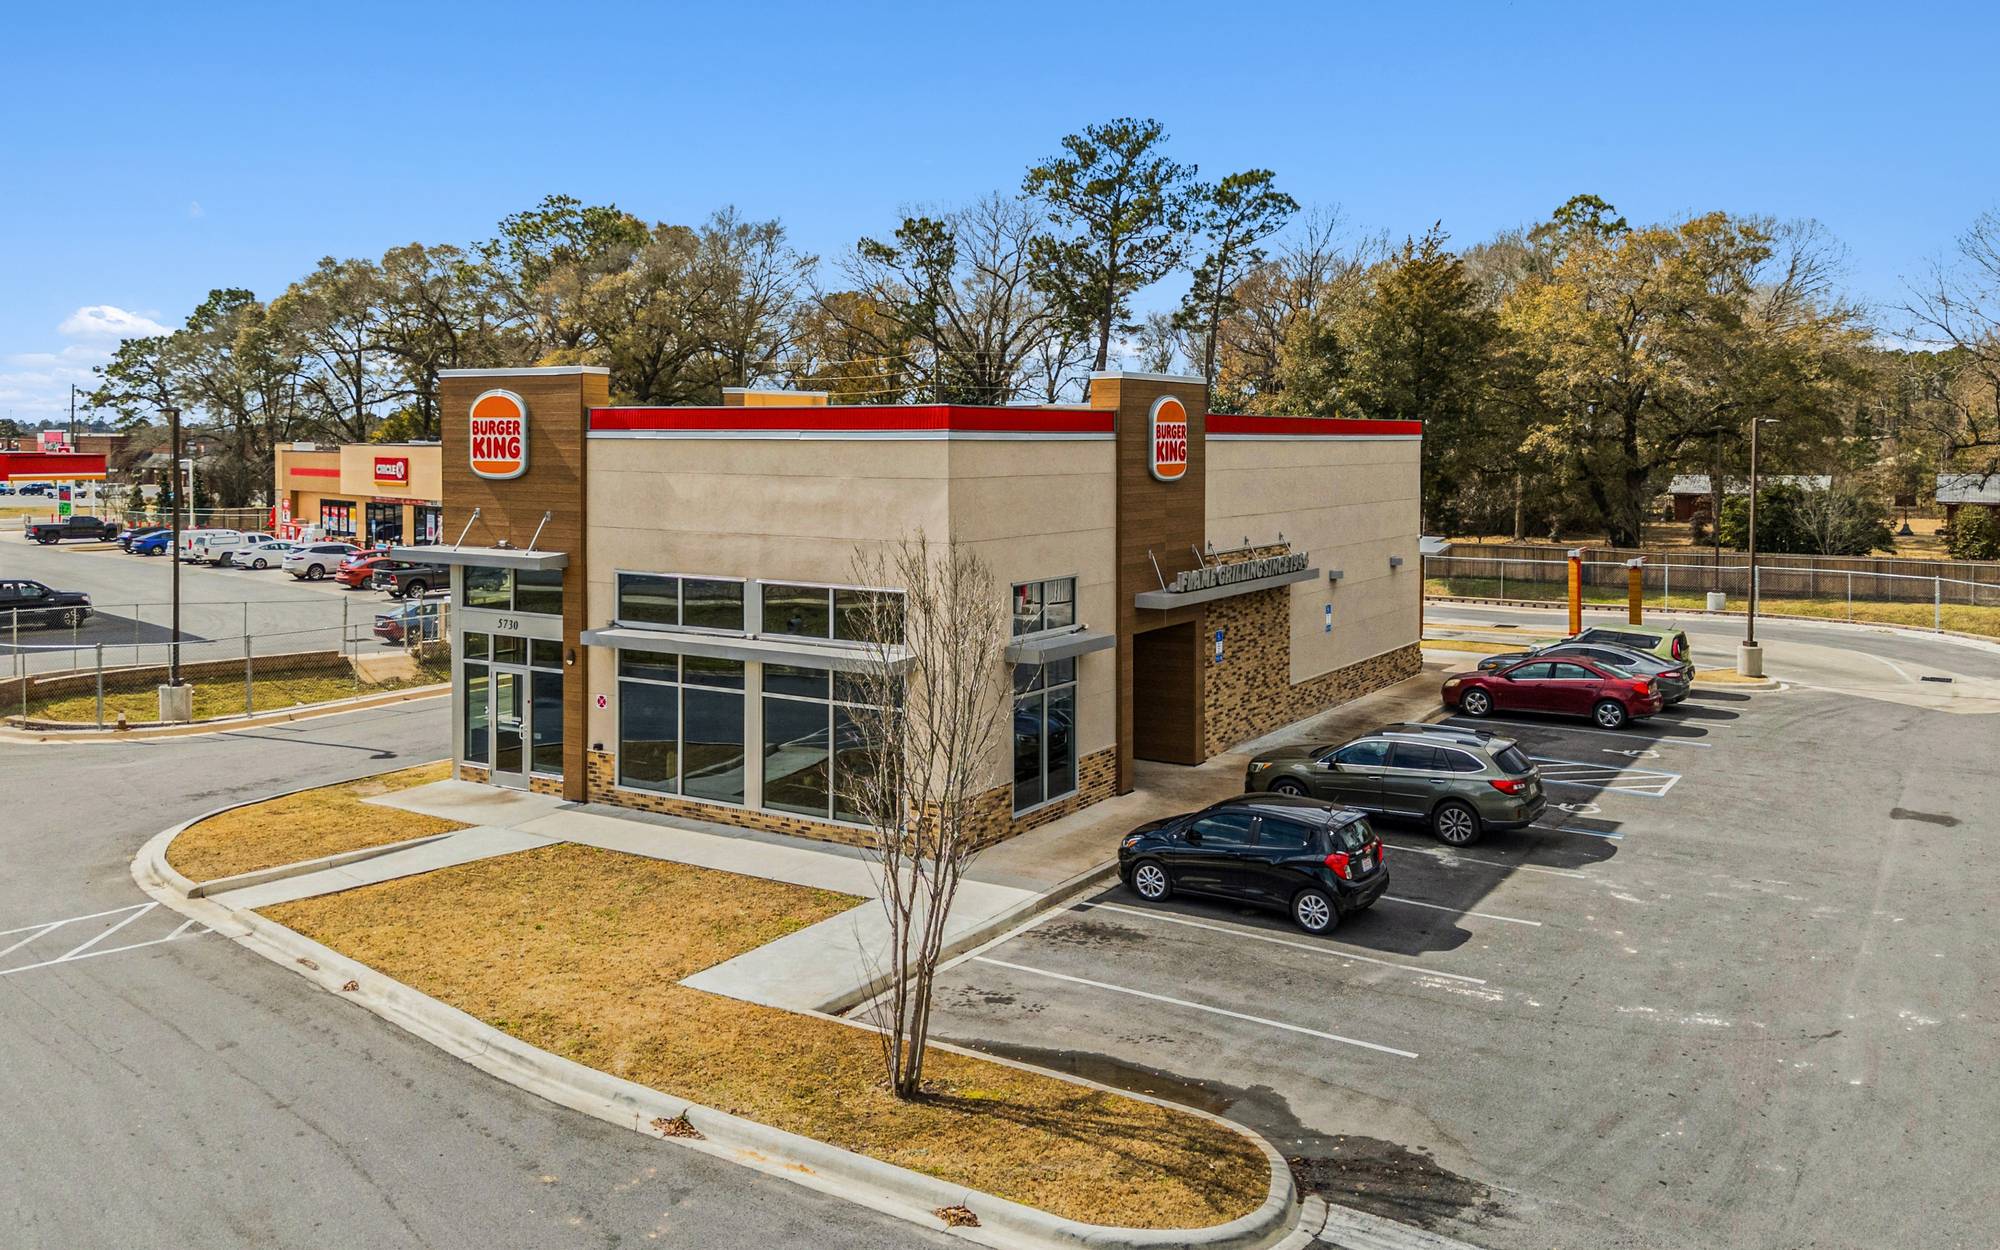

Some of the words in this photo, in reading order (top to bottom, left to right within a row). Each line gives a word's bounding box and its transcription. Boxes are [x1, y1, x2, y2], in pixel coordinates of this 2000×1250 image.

[472, 420, 521, 435] BURGER
[1155, 424, 1186, 439] BURGER
[472, 436, 521, 459] KING
[1156, 440, 1186, 462] KING
[376, 464, 397, 475] CIRCLE
[1177, 568, 1217, 593] FLAME
[1217, 558, 1264, 586] GRILLING
[1263, 554, 1291, 577] SINCE
[497, 618, 519, 630] 5730
